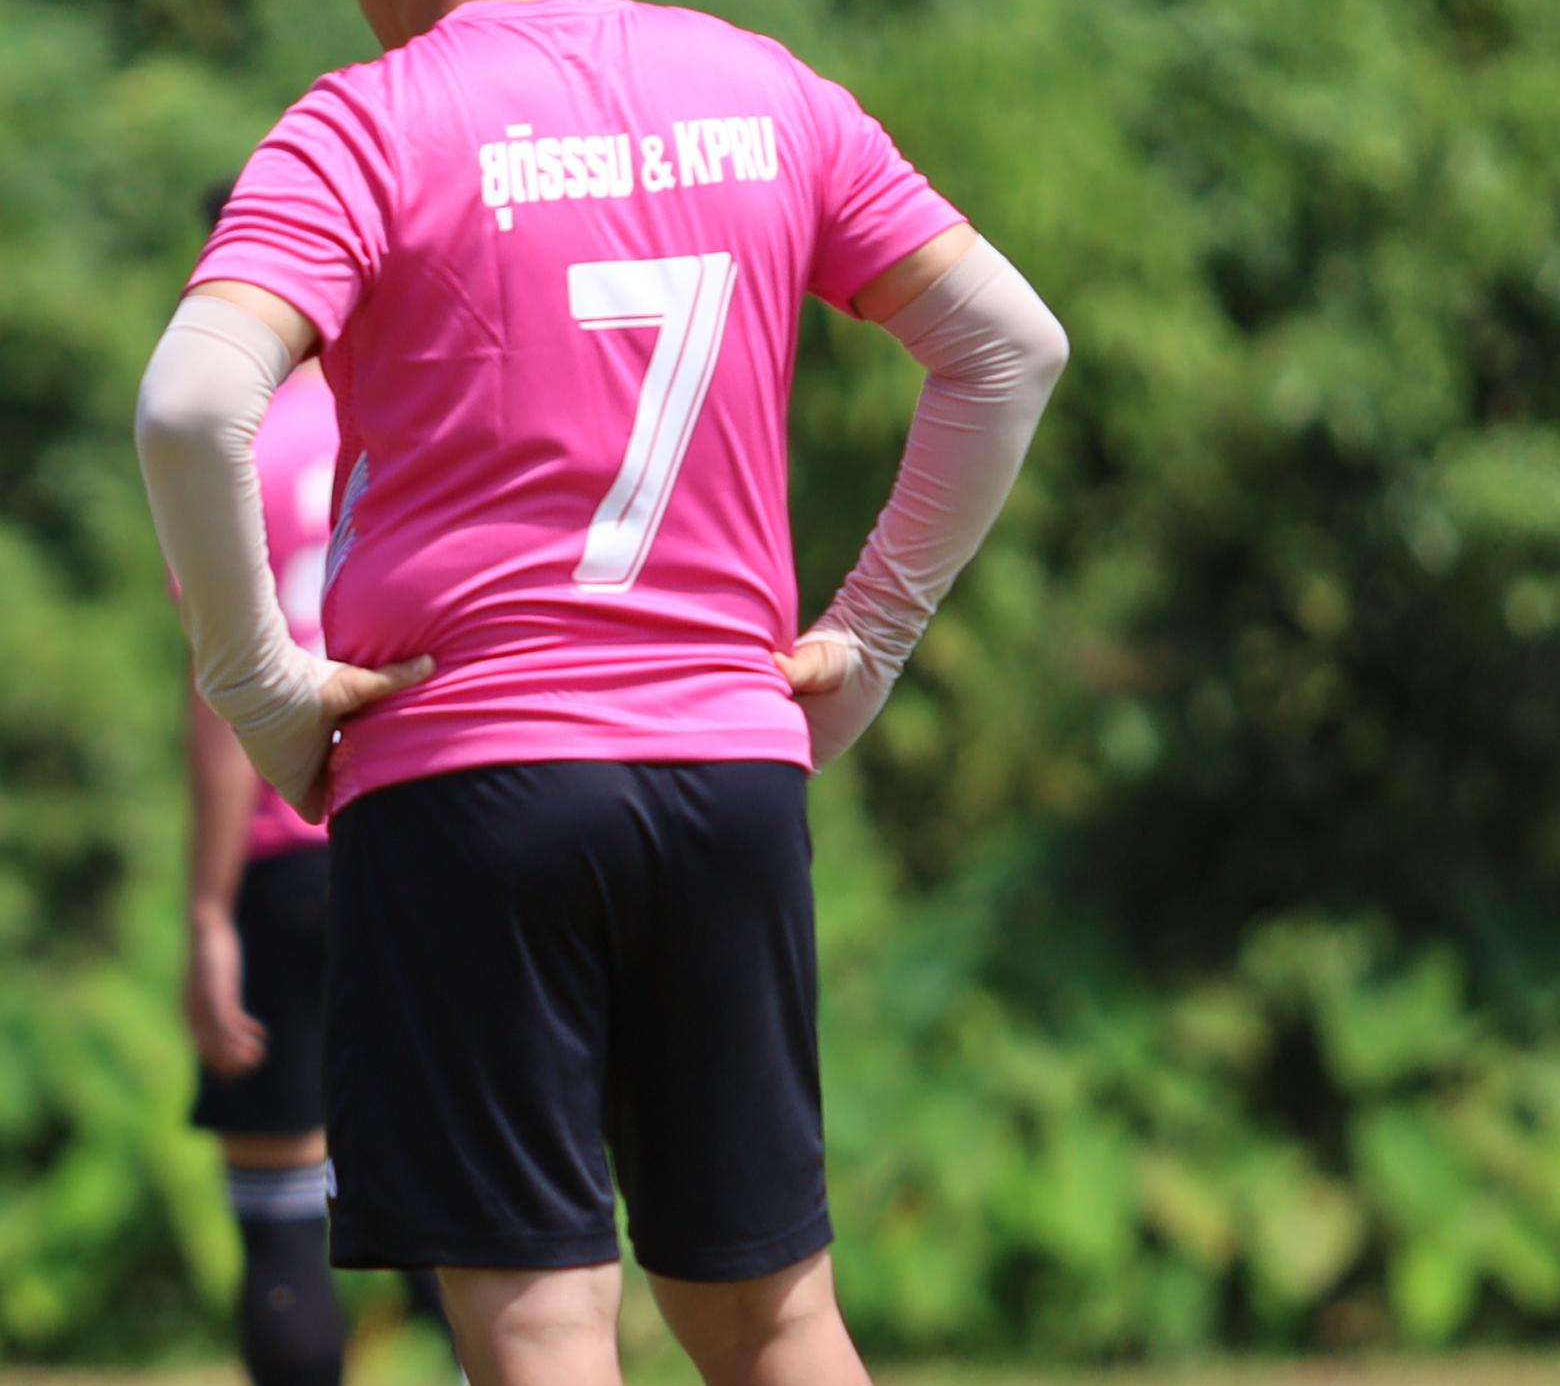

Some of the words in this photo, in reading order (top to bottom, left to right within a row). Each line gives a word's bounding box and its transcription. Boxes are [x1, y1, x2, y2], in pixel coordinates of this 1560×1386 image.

[640, 134, 676, 193] &
[672, 115, 779, 187] KPRU
[567, 251, 738, 593] 7
